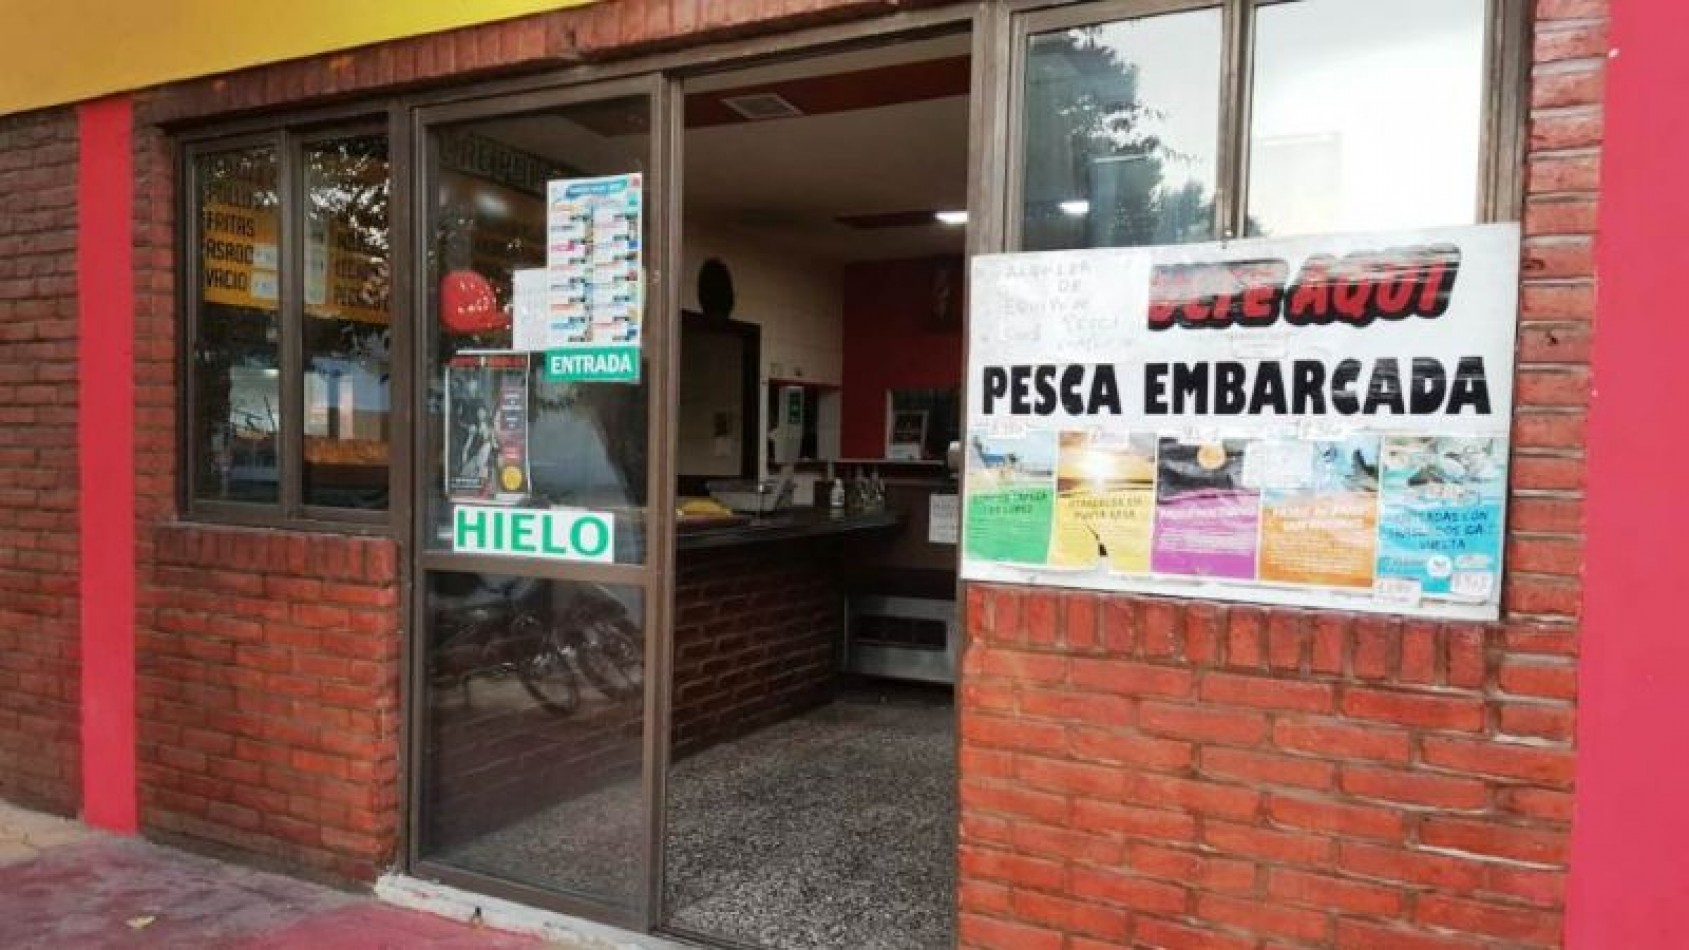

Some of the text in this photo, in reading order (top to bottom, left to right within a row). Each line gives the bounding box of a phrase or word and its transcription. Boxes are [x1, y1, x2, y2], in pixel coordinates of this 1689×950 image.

[551, 354, 633, 375] ENTRADA
[983, 355, 1492, 416] PESCA EMBARCADA
[457, 509, 609, 557] HIELO
